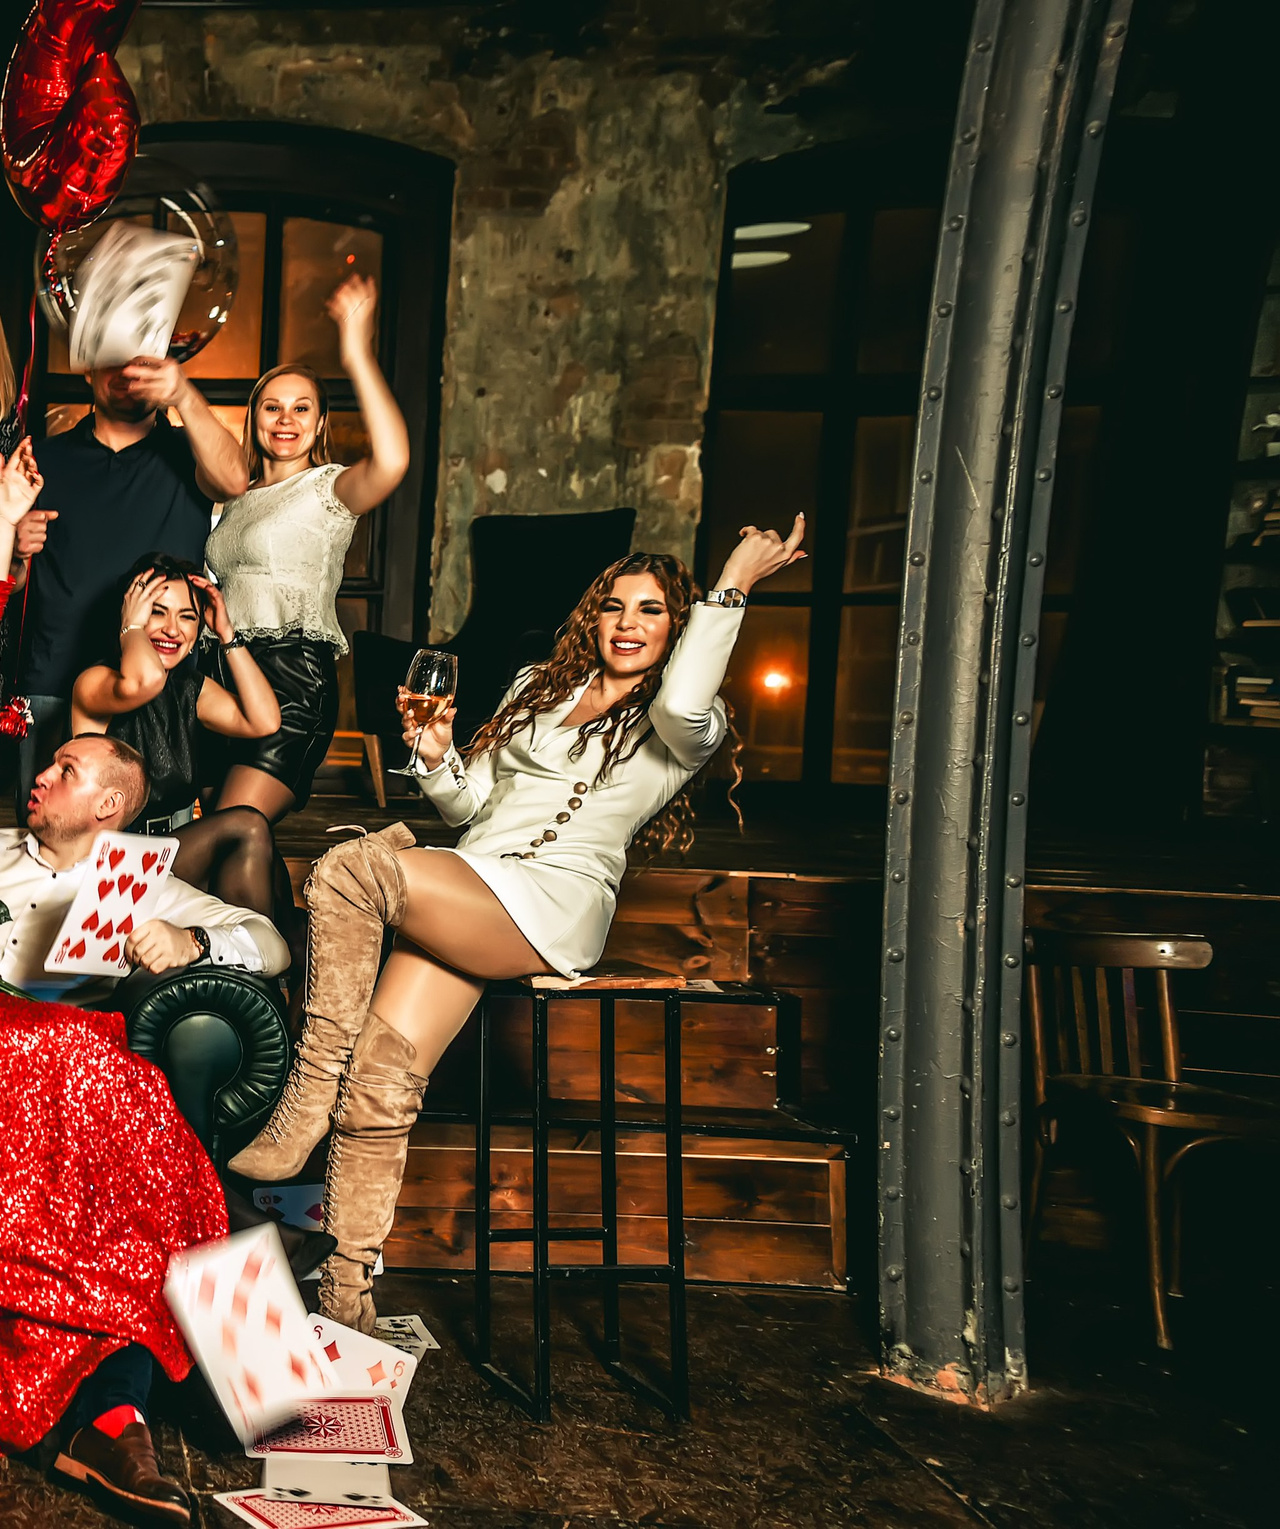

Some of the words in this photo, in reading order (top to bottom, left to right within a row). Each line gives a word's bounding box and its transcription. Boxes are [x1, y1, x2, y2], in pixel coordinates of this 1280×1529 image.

[159, 847, 171, 864] 10
[259, 1195, 272, 1205] 8
[393, 1360, 406, 1377] 6
